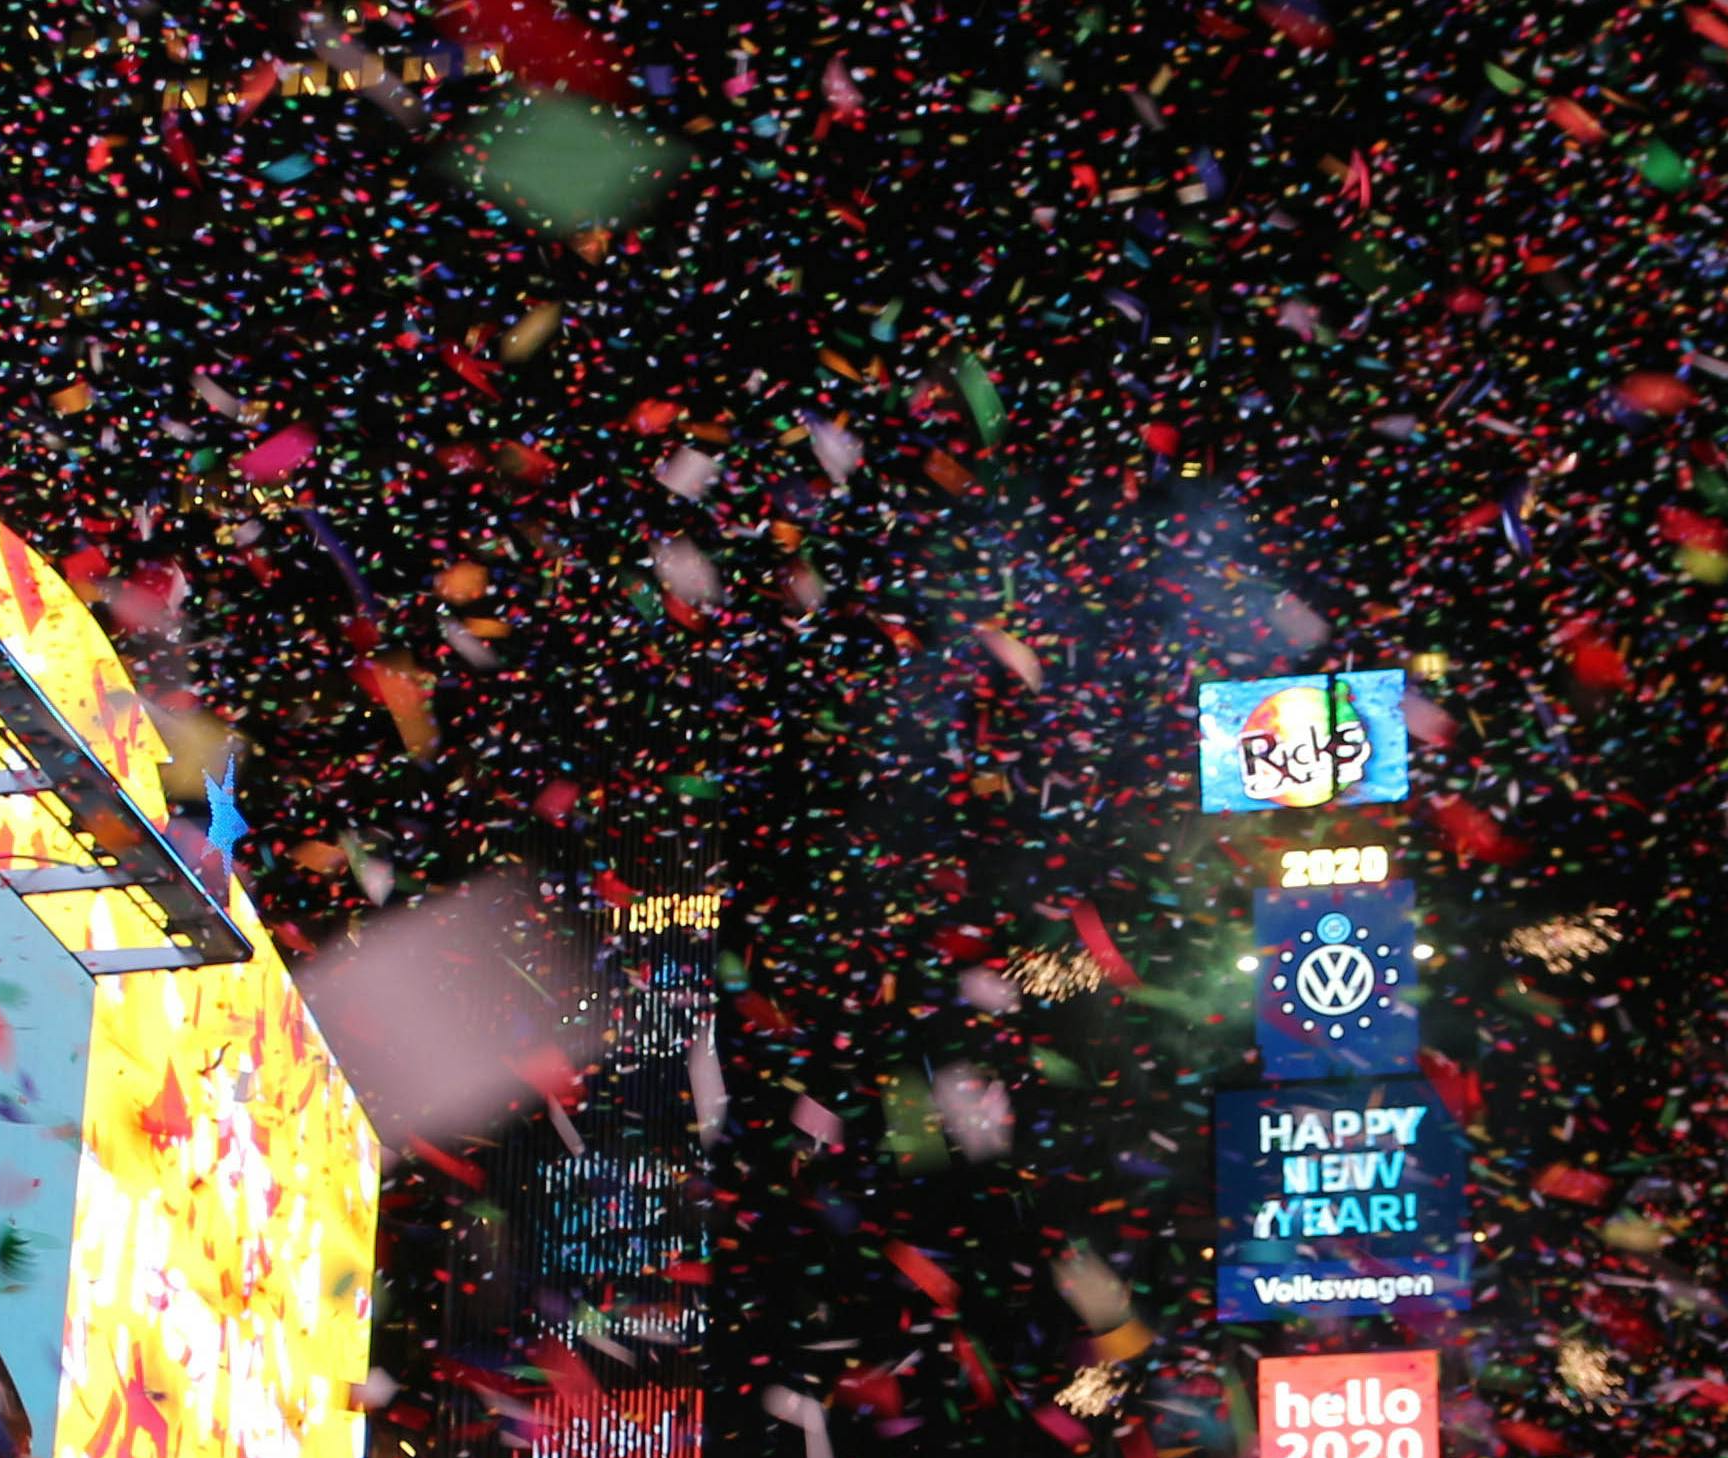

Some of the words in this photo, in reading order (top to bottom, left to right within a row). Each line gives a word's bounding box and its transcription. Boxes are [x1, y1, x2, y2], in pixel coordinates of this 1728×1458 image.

[1281, 846, 1389, 888] 2020
[1260, 1105, 1427, 1153] HAPPY
[1283, 1151, 1405, 1194] NEW
[1254, 1193, 1418, 1239] YEAR!
[1253, 1274, 1434, 1304] Volkswagen
[1274, 1378, 1422, 1428] hello
